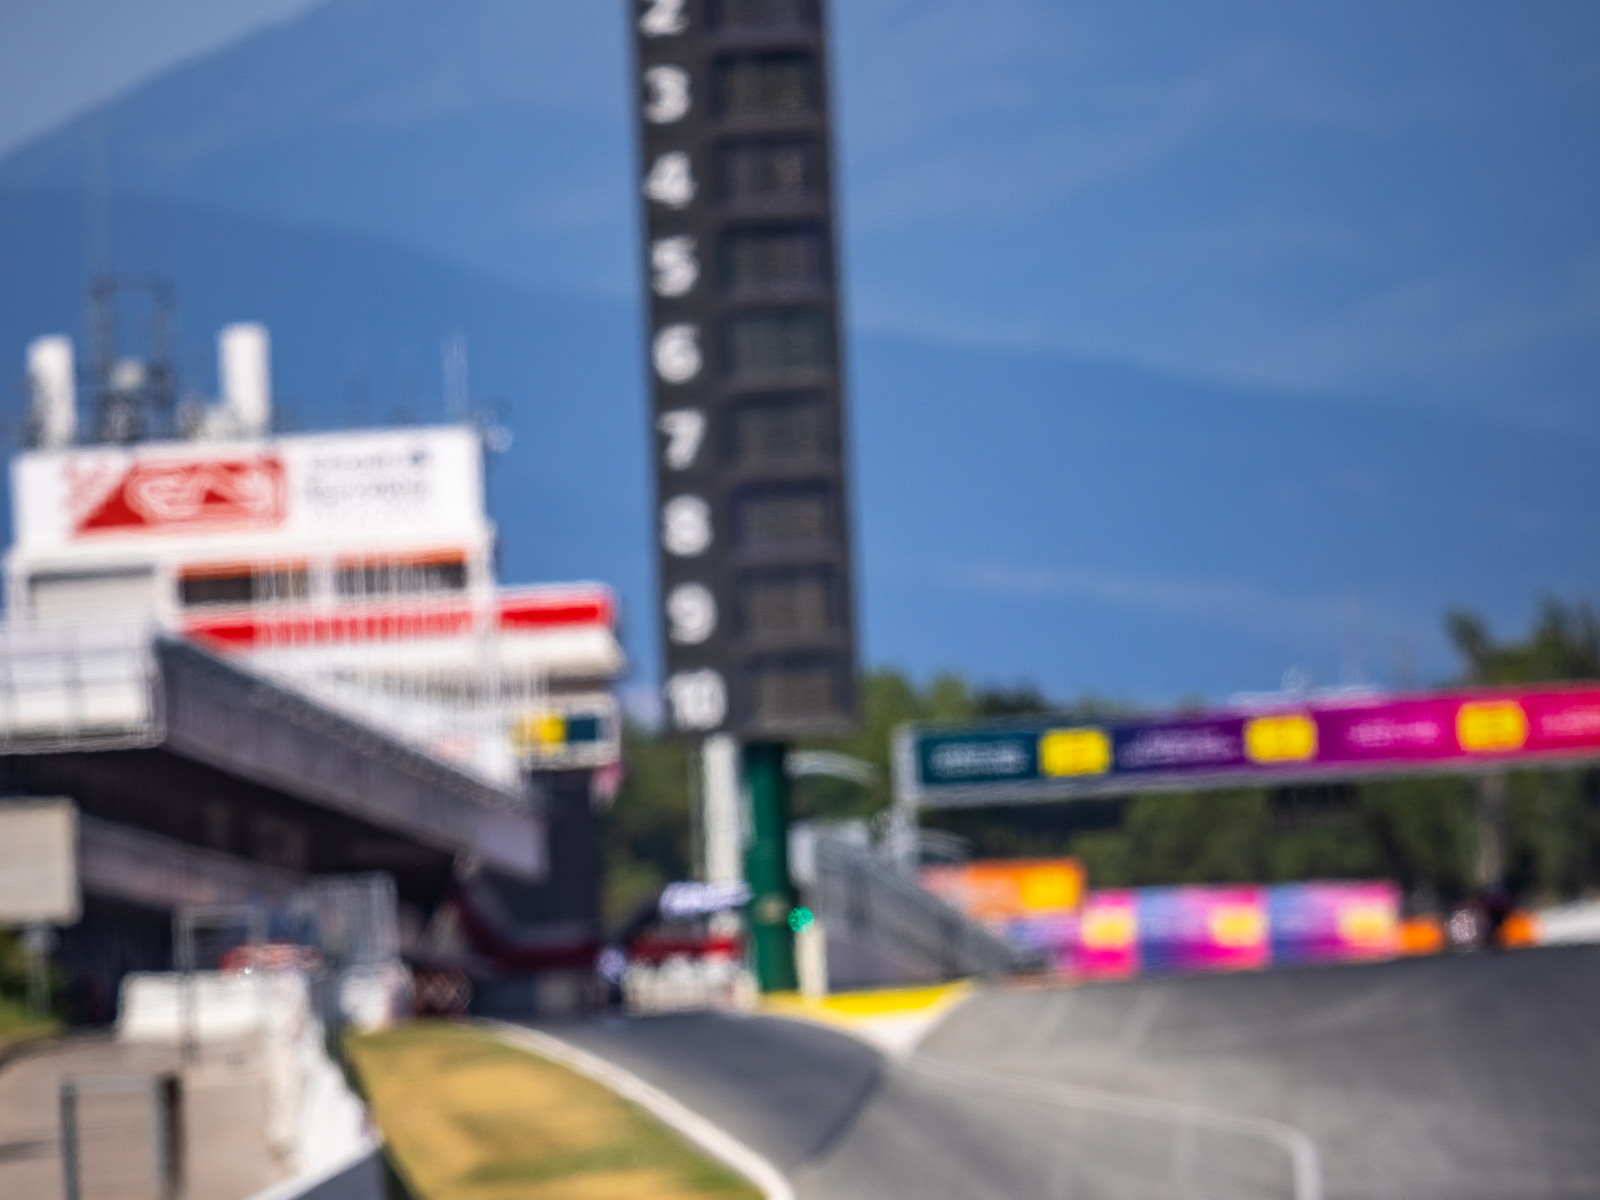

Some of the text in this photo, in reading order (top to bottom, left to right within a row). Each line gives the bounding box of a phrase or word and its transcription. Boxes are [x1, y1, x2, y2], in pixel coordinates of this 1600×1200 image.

[646, 66, 690, 123] 3
[645, 152, 696, 208] 4
[652, 237, 697, 296] 5
[654, 324, 701, 382] 6
[659, 408, 706, 470] 7
[663, 496, 713, 556] 8
[667, 583, 716, 644] 9
[665, 669, 727, 731] 10
